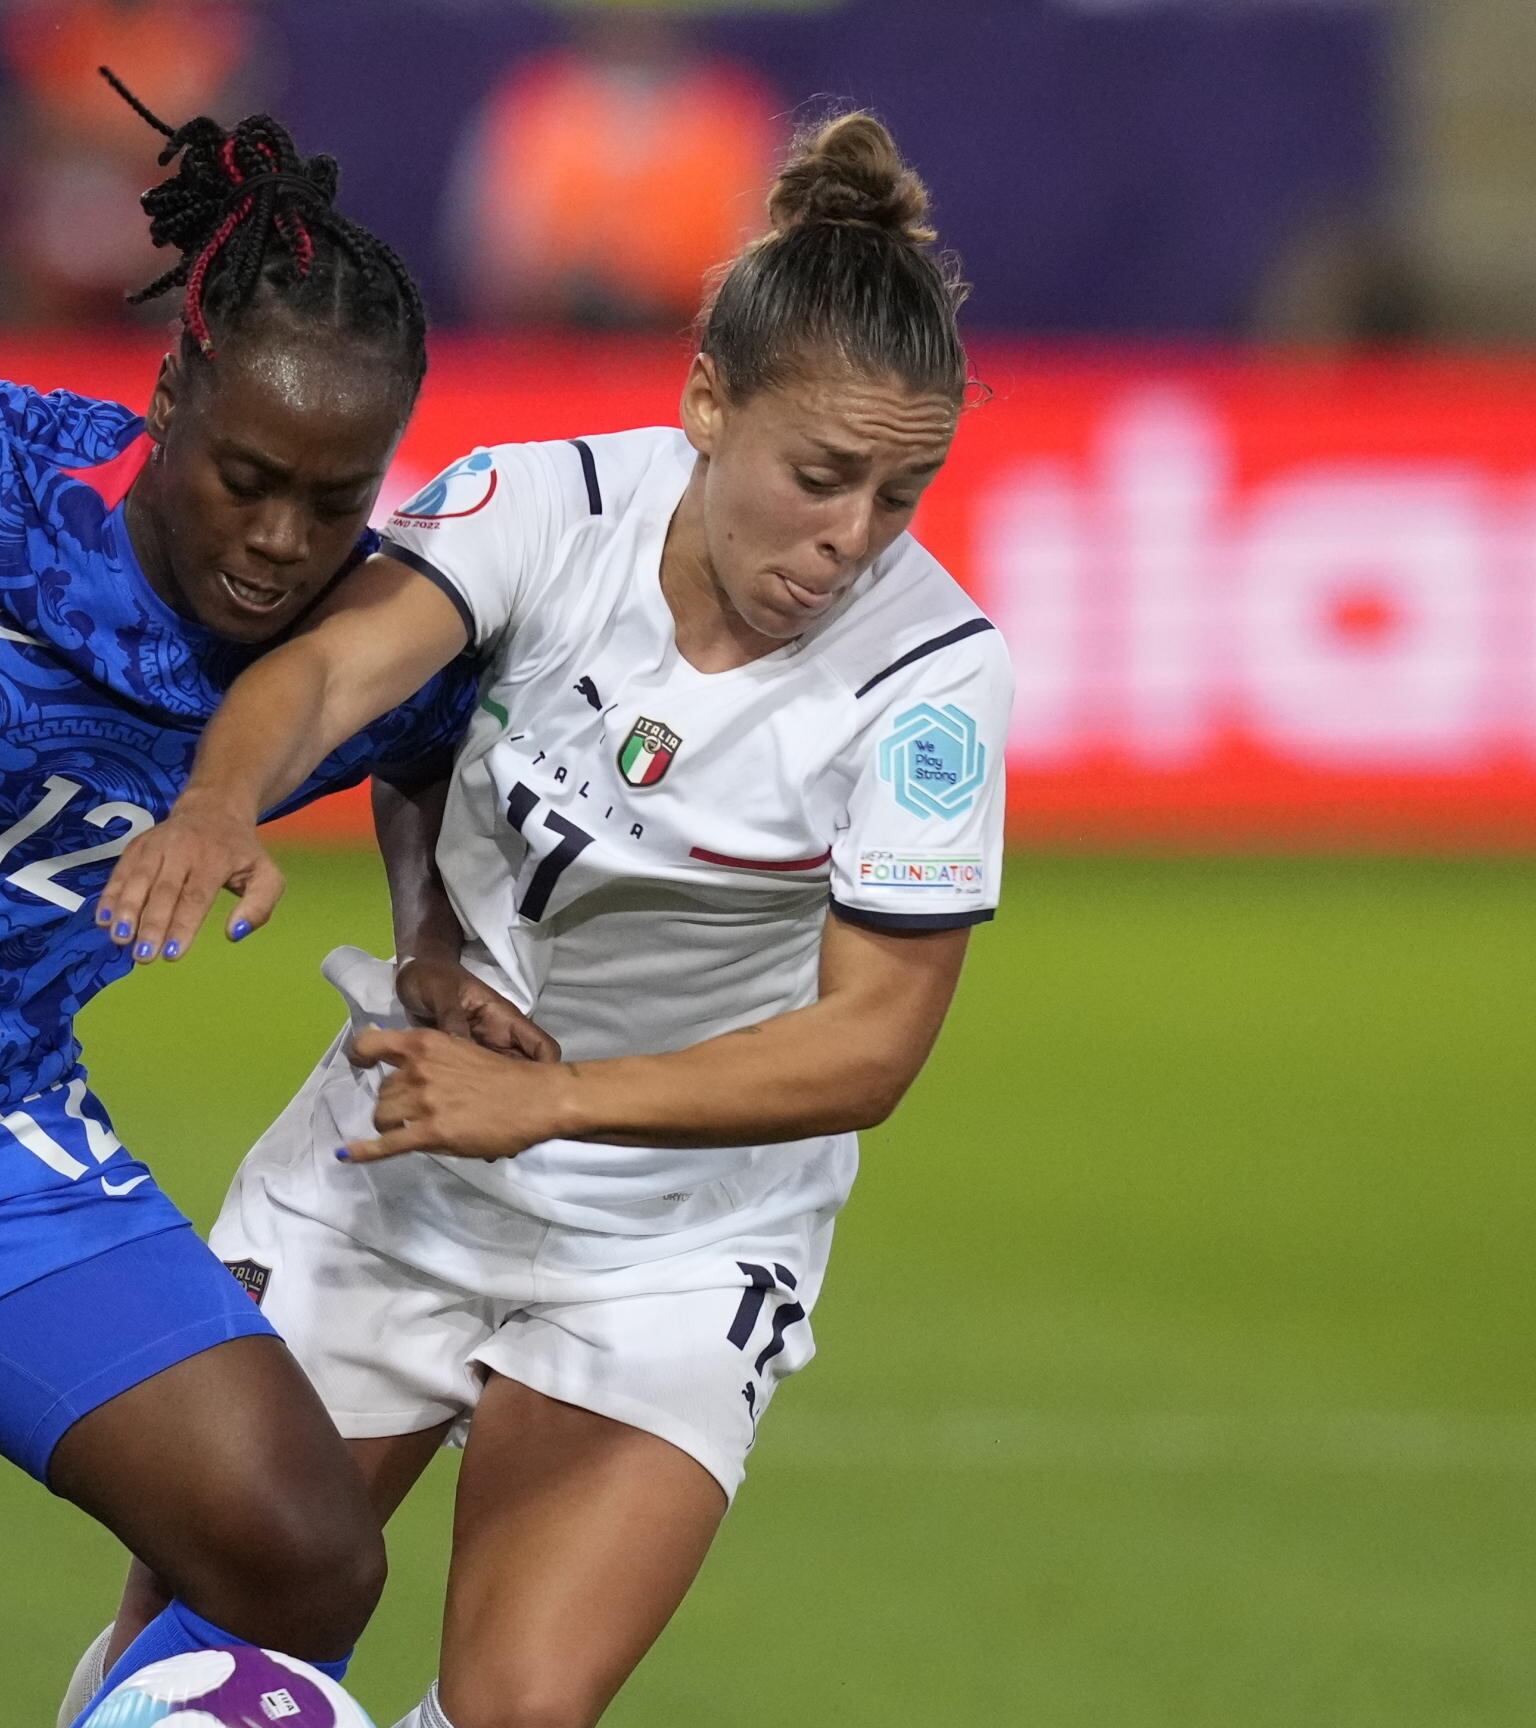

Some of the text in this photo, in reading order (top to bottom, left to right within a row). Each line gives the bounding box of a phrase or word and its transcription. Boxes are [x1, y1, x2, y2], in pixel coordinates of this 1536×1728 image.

[412, 520, 441, 529] 2022
[637, 719, 679, 750] ITALIA
[914, 740, 936, 752] We
[915, 753, 944, 771] Play
[915, 767, 958, 785] Strong
[507, 781, 597, 923] 17
[227, 1266, 266, 1286] TALIA
[726, 1260, 806, 1379] 17
